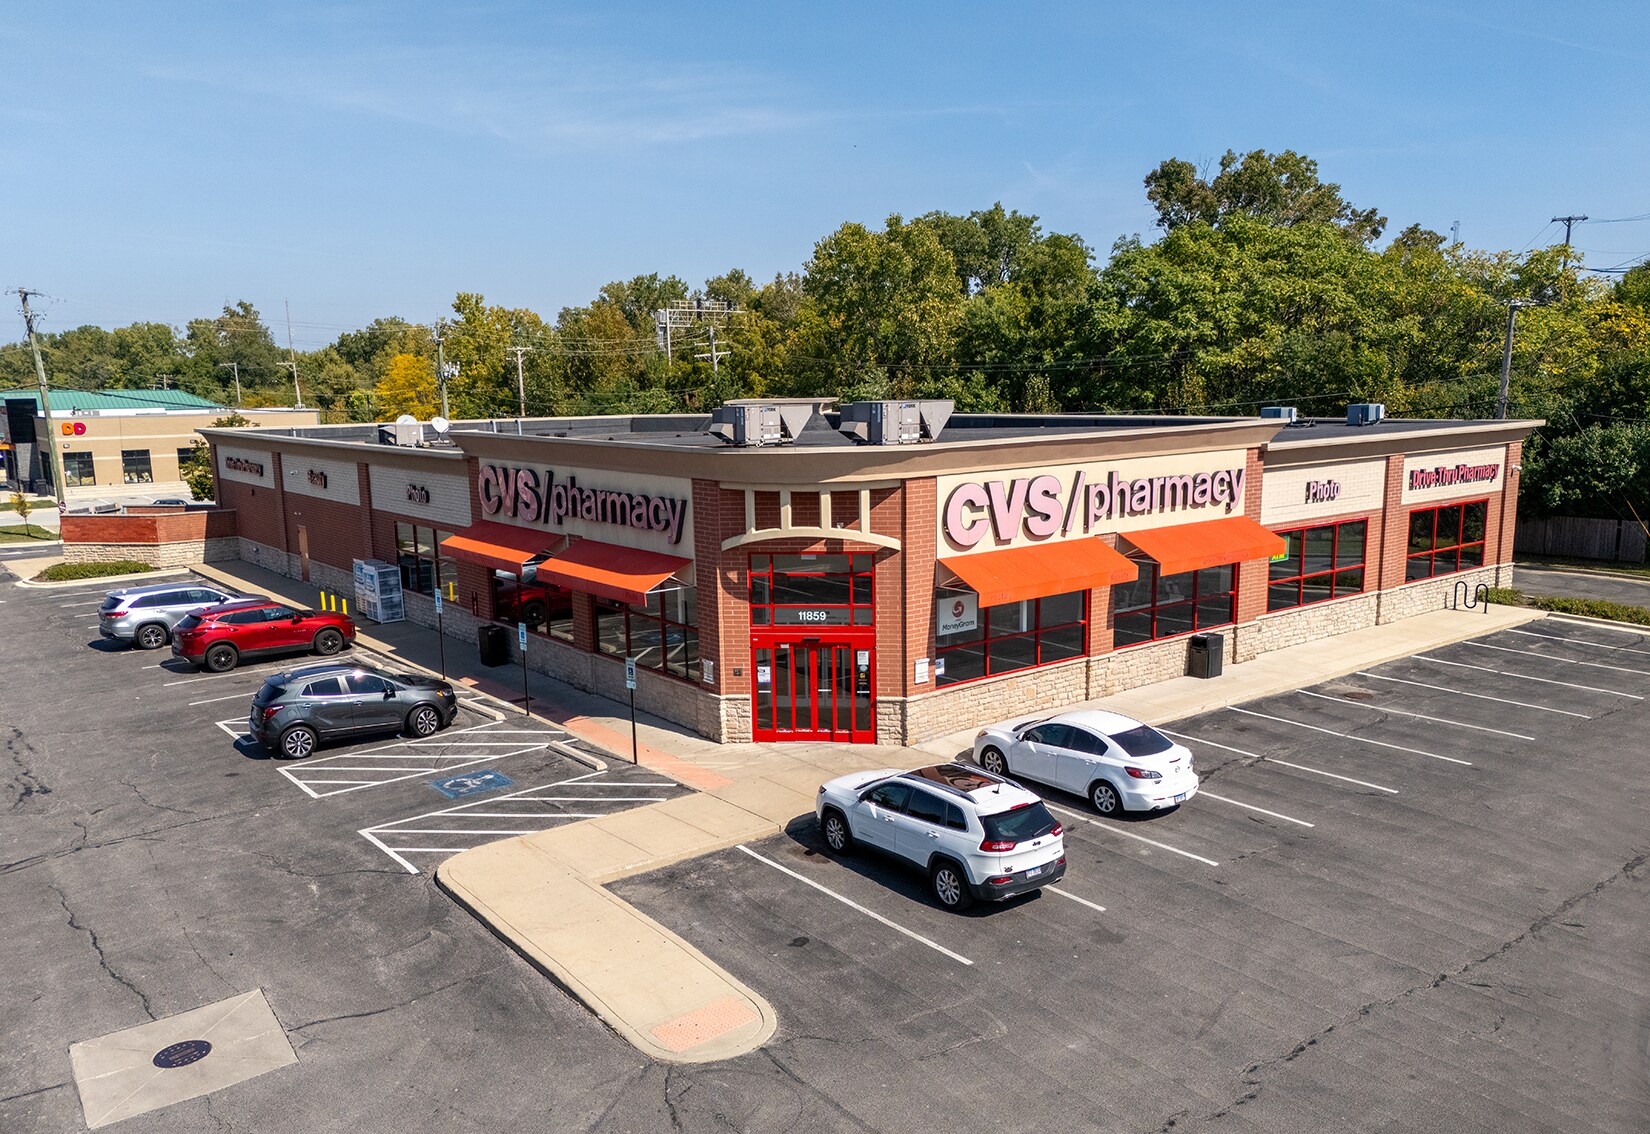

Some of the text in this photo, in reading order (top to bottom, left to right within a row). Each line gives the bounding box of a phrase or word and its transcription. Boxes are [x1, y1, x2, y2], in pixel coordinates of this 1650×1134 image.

[61, 422, 87, 436] DD
[1458, 463, 1500, 482] Pharmacy
[406, 484, 430, 504] Photo
[1306, 480, 1341, 502] Photo
[798, 611, 827, 621] 11859
[942, 619, 975, 631] MoneyGram
